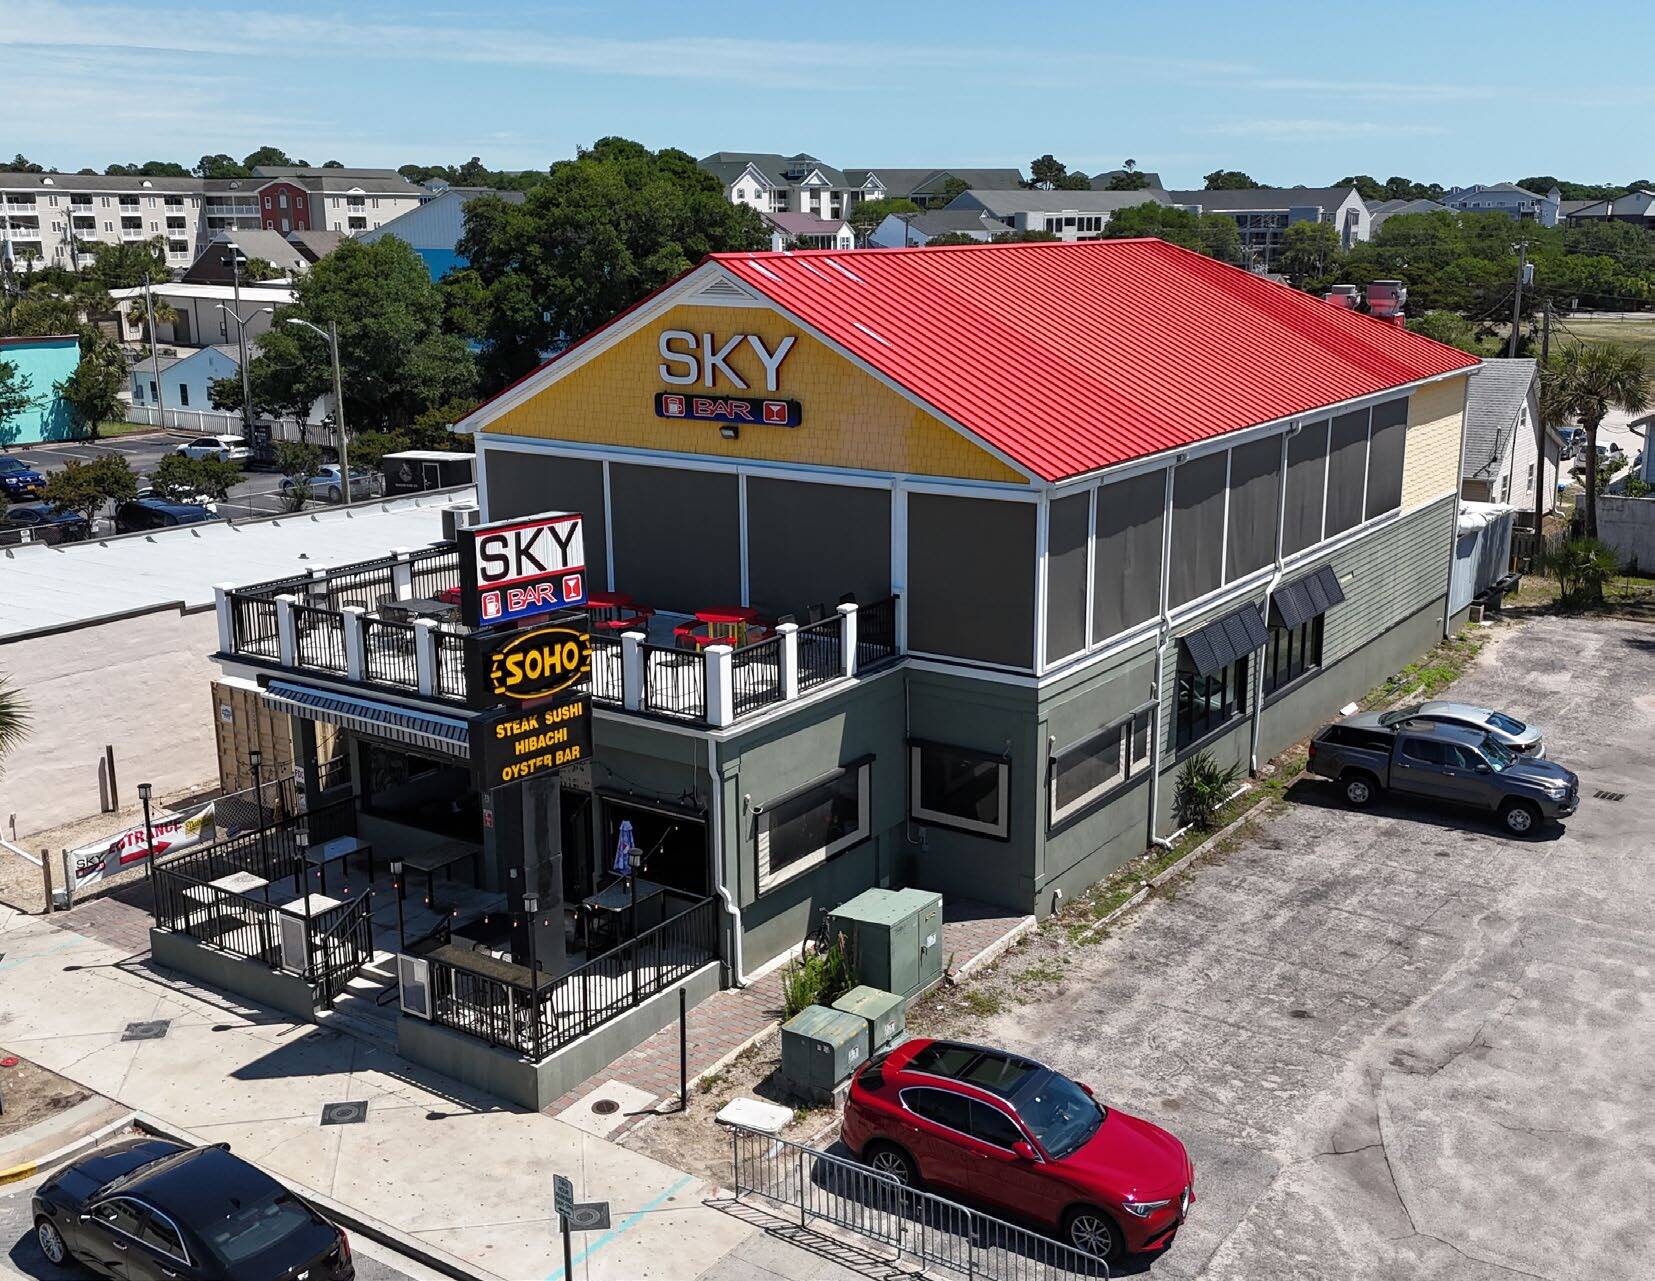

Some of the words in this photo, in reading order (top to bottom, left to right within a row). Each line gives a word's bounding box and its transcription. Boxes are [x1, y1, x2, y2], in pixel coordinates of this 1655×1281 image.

[659, 329, 798, 391] SKY
[693, 398, 754, 420] BAR
[480, 521, 579, 582] SKY
[507, 583, 557, 611] BAR
[506, 641, 579, 686] SOHO
[496, 714, 539, 738] STEAK
[545, 702, 583, 725] SUSHI
[515, 727, 568, 755] HIBACHI
[502, 754, 552, 780] OYSTER
[555, 745, 580, 765] BAR
[109, 820, 182, 854] TRANCE
[76, 852, 105, 869] SKY
